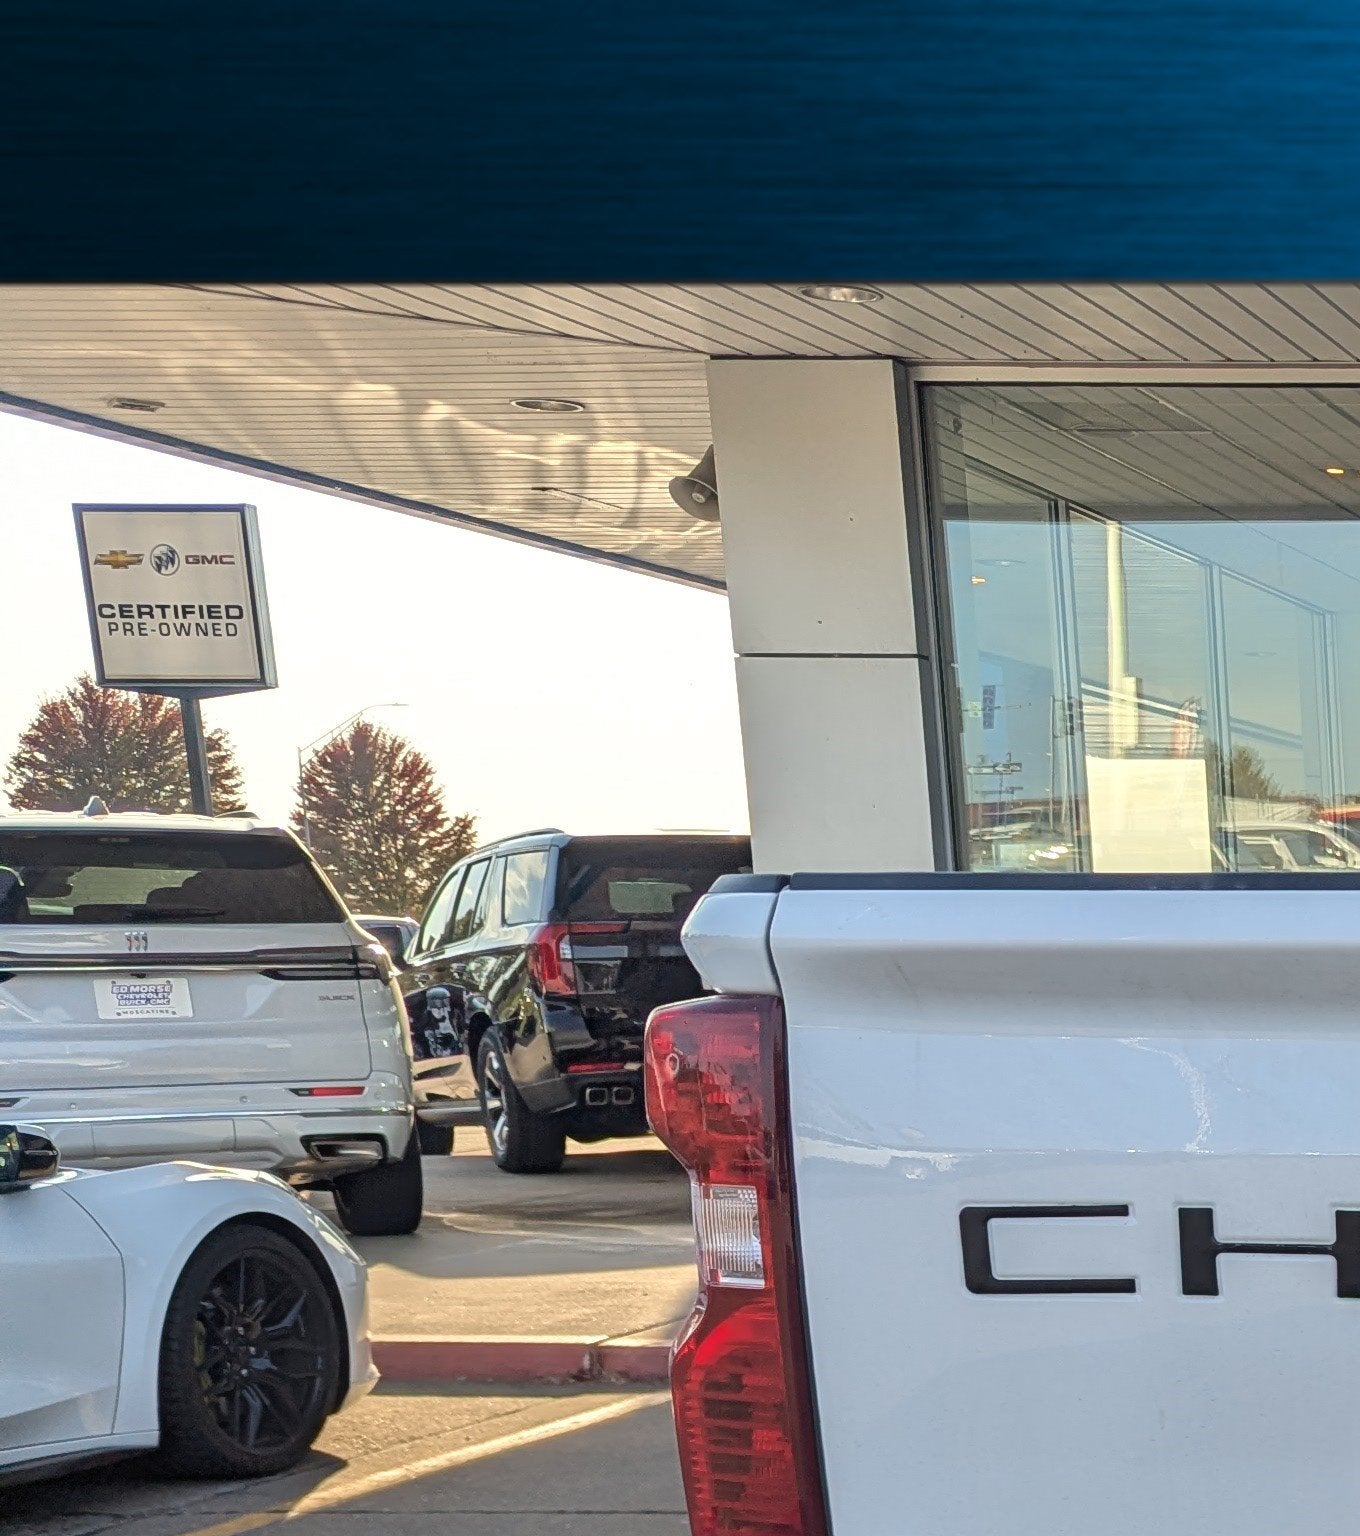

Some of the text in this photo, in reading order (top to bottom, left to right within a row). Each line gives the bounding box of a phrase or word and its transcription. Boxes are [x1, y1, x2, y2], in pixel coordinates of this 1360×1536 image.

[184, 554, 236, 565] GMC
[97, 603, 244, 620] CERTIFIED
[108, 622, 238, 637] PRE-OWNED
[112, 985, 172, 994] ED MORSE
[117, 992, 170, 1000] CHEVROLET
